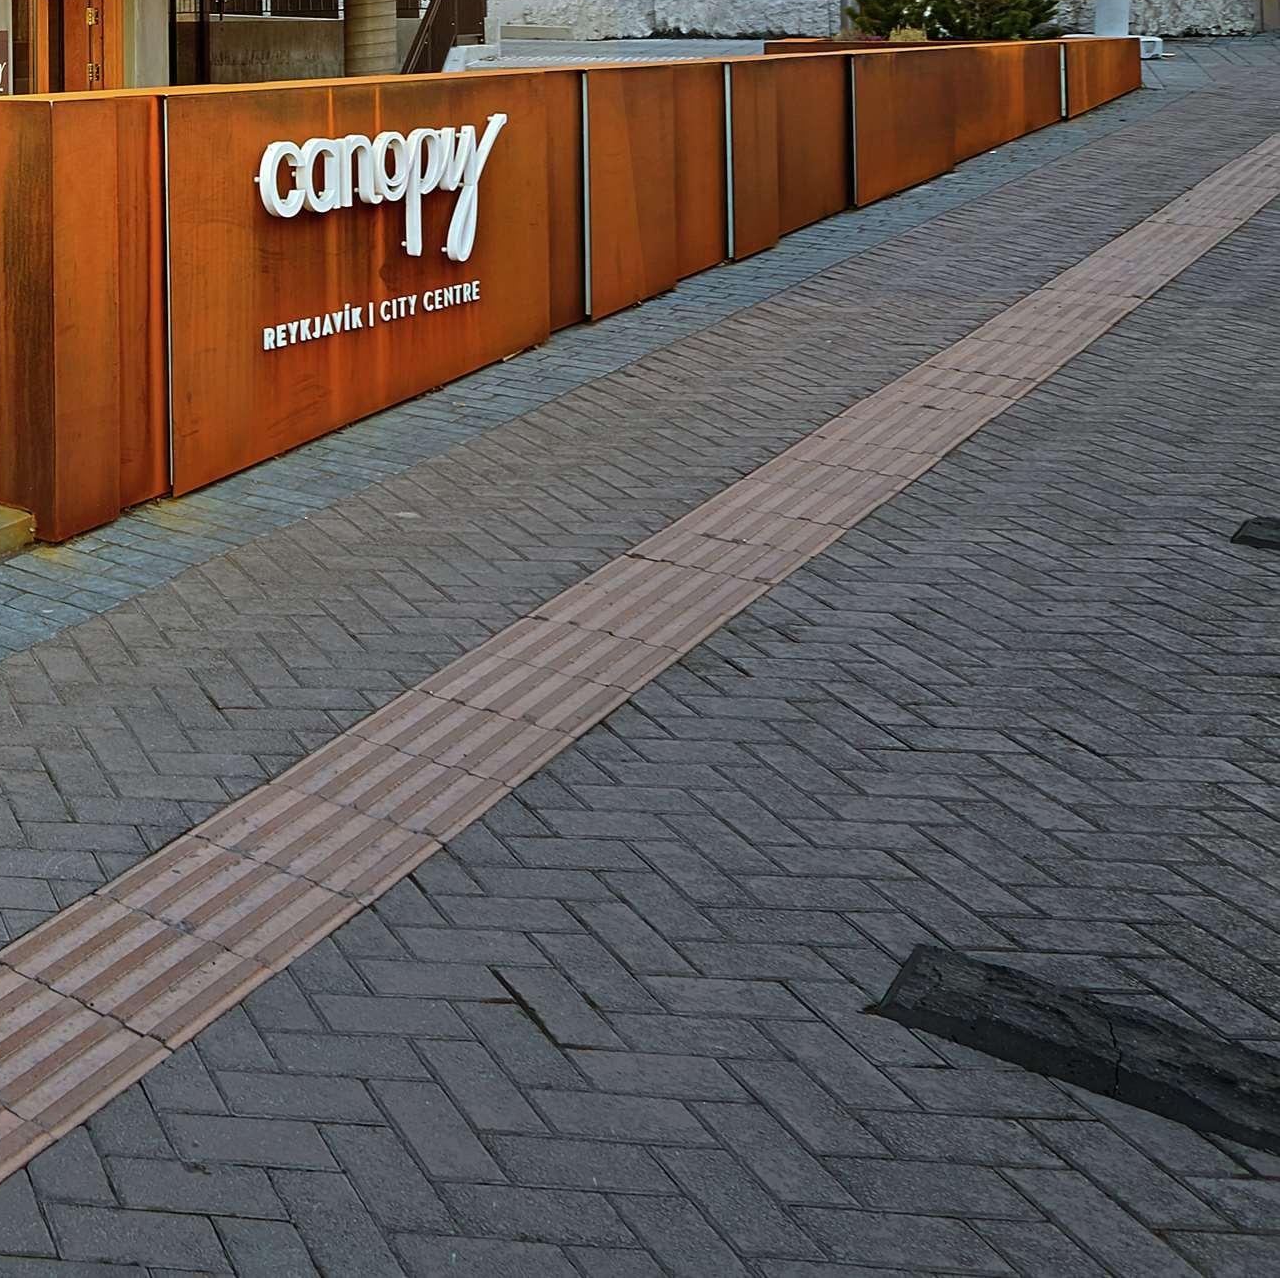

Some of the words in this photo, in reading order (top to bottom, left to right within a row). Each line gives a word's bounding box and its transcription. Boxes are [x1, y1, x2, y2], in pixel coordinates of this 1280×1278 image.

[258, 113, 508, 263] canopy
[262, 302, 363, 351] REYKJAVÍK
[379, 294, 417, 322] CITY
[422, 280, 481, 312] CENTRE
